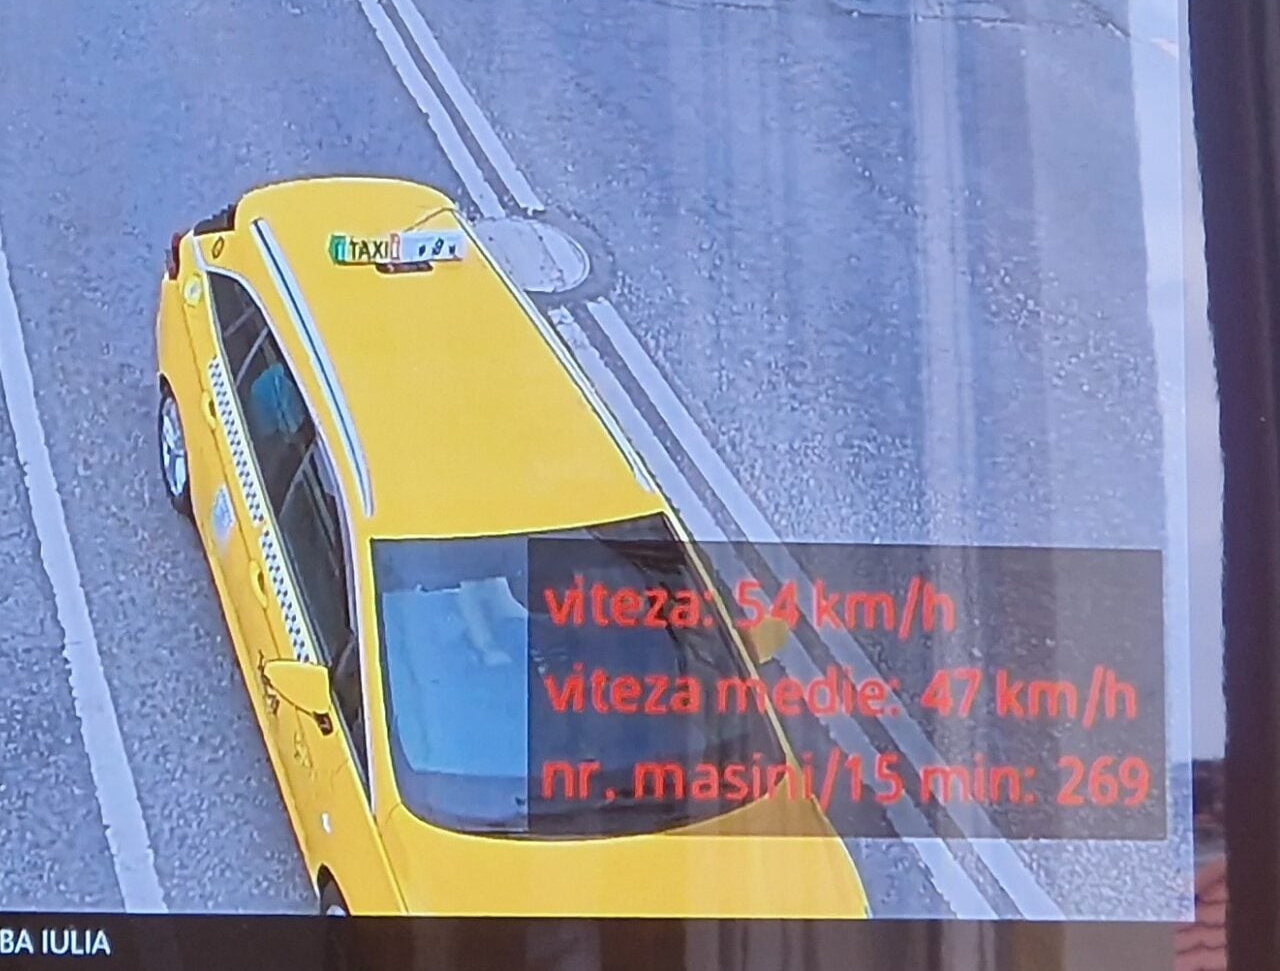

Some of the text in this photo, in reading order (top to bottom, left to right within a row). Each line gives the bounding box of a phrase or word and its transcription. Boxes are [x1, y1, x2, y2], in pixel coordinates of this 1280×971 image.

[349, 235, 389, 260] TAXI
[544, 577, 955, 638] viteza: 54 km/h
[544, 664, 1137, 726] viteza medie: 47 km/h
[542, 749, 1150, 812] nr. masini/15 min: 269
[42, 928, 111, 956] IULIA
